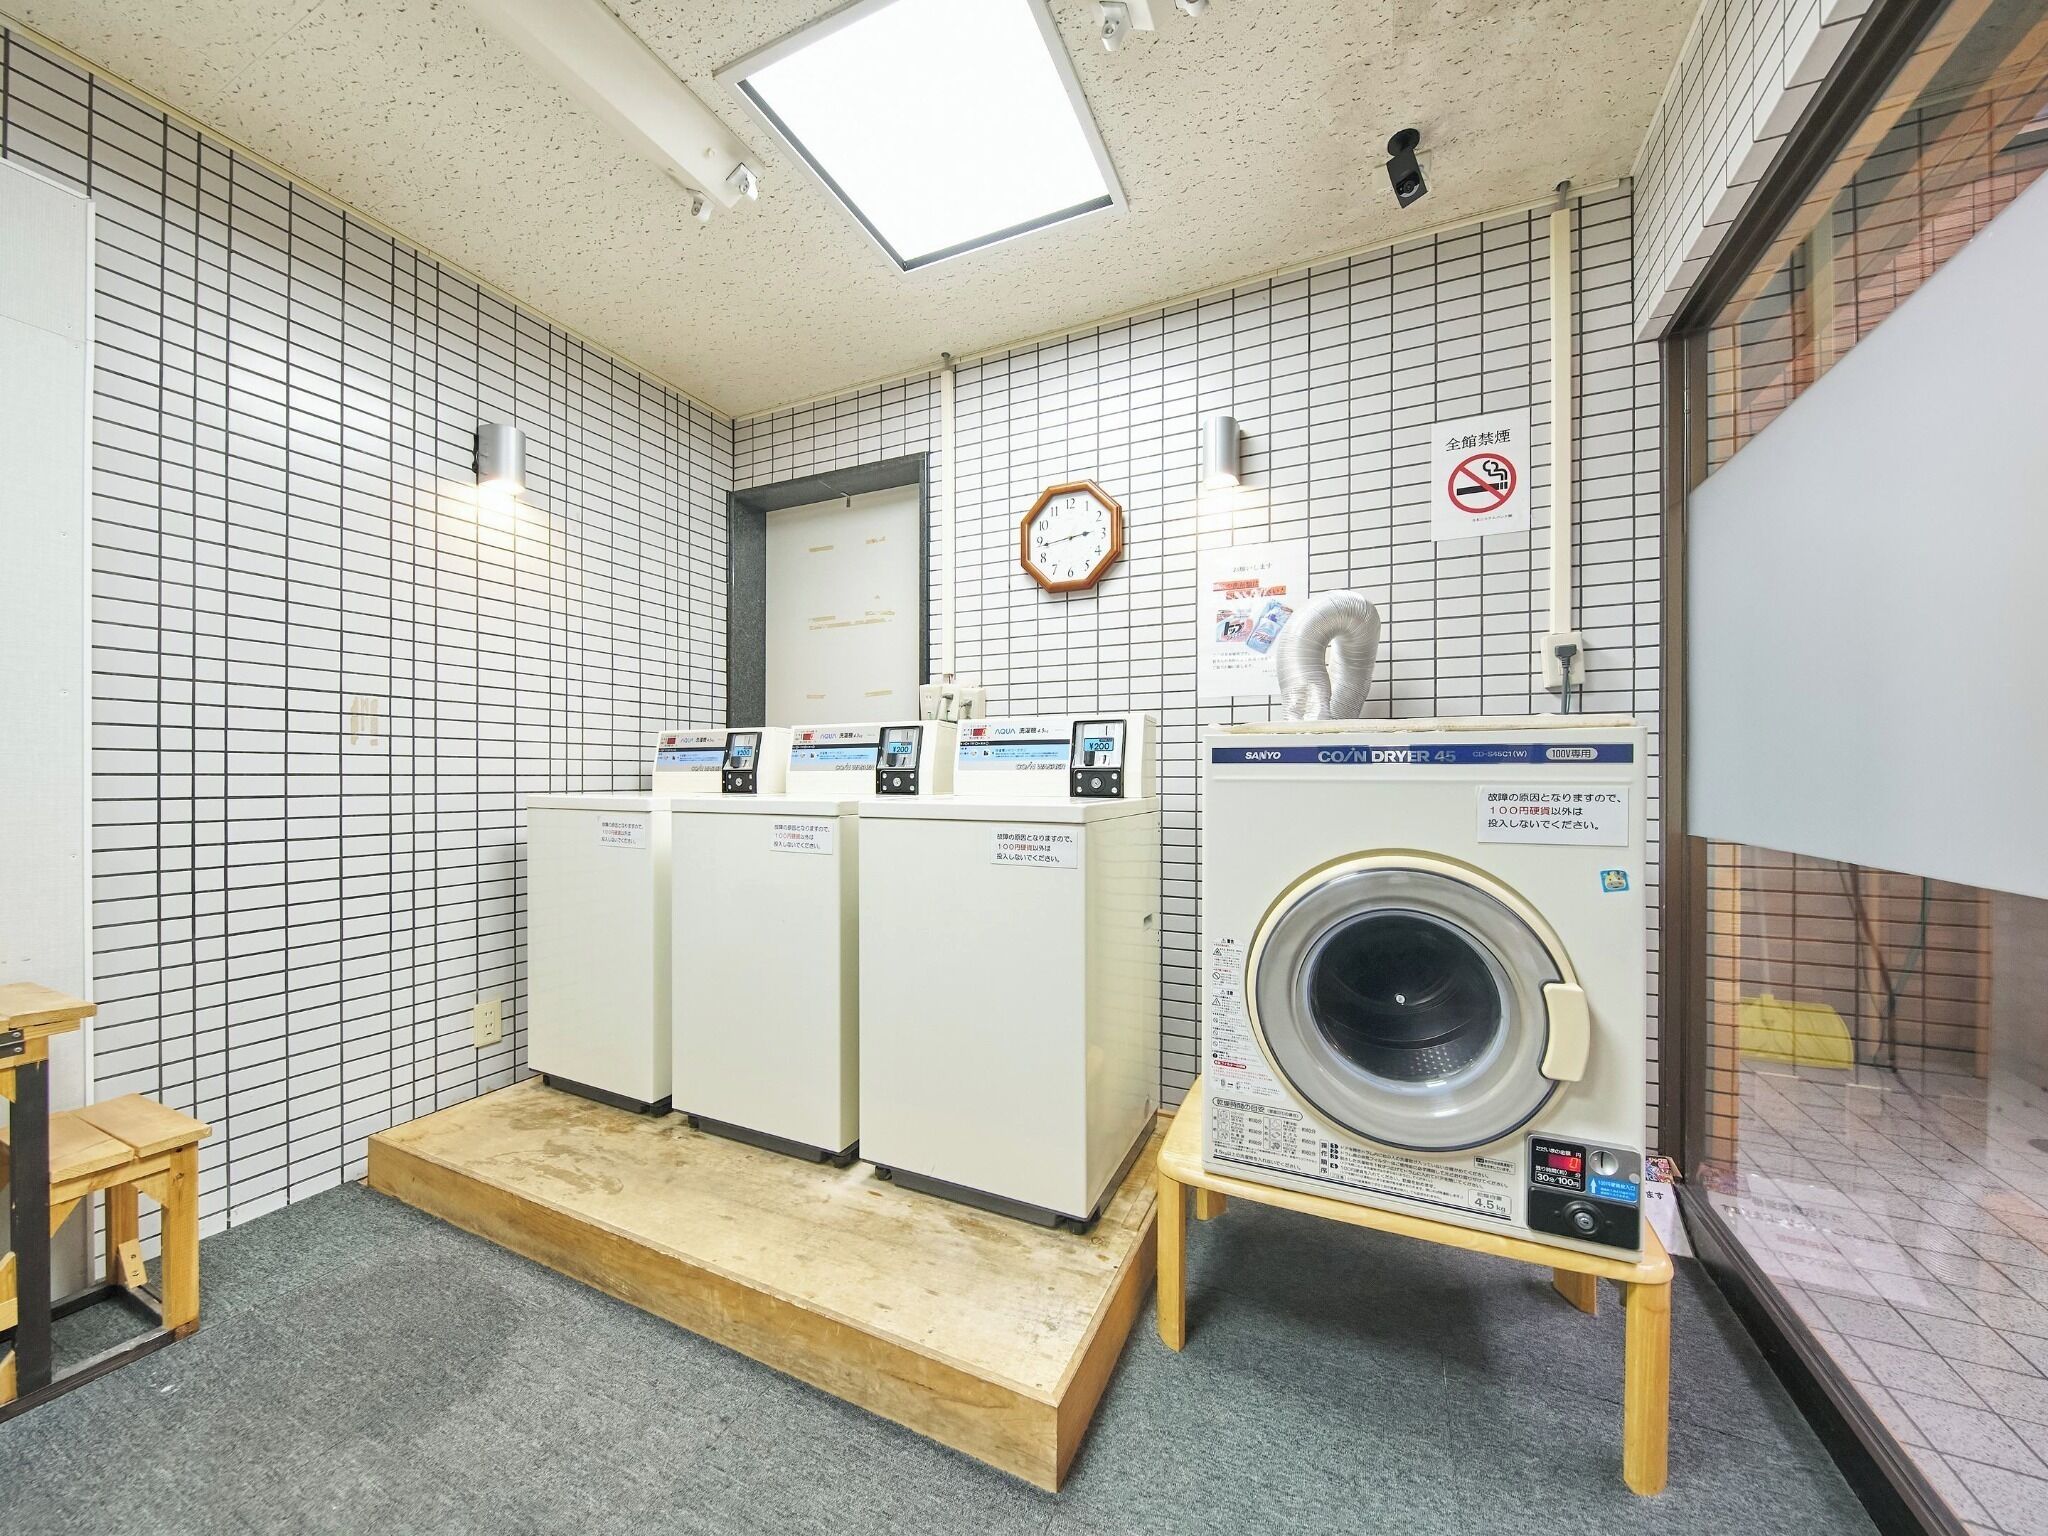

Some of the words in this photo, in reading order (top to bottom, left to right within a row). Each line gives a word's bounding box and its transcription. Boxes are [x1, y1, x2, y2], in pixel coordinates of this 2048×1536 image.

[1445, 428, 1512, 453] 全館禁煙
[1066, 498, 1076, 510] 12
[1086, 500, 1089, 511] 1
[1050, 506, 1058, 517] 11
[1096, 510, 1102, 522] 2
[1039, 520, 1049, 531] 10
[1101, 527, 1106, 539] 3
[1036, 536, 1043, 546] 9
[1094, 545, 1102, 556] 4
[1040, 552, 1047, 564] 8
[1052, 564, 1058, 575] 7
[1084, 560, 1090, 571] 5
[1068, 567, 1074, 578] 6
[1090, 742, 1110, 750] ¥200
[1245, 751, 1281, 760] SANYO
[1372, 750, 1430, 763] DRYER
[1434, 750, 1456, 763] 45
[1488, 793, 1622, 803] 故障の原因となりますので、
[1488, 819, 1600, 830] 投入しないでください。
[996, 833, 1073, 843] 故障の原因となりますので、
[996, 852, 1060, 863] 投入しないでください。
[1537, 1173, 1580, 1188] 30分/100円
[1474, 1198, 1494, 1210] 4.5
[1496, 1205, 1506, 1213] kg
